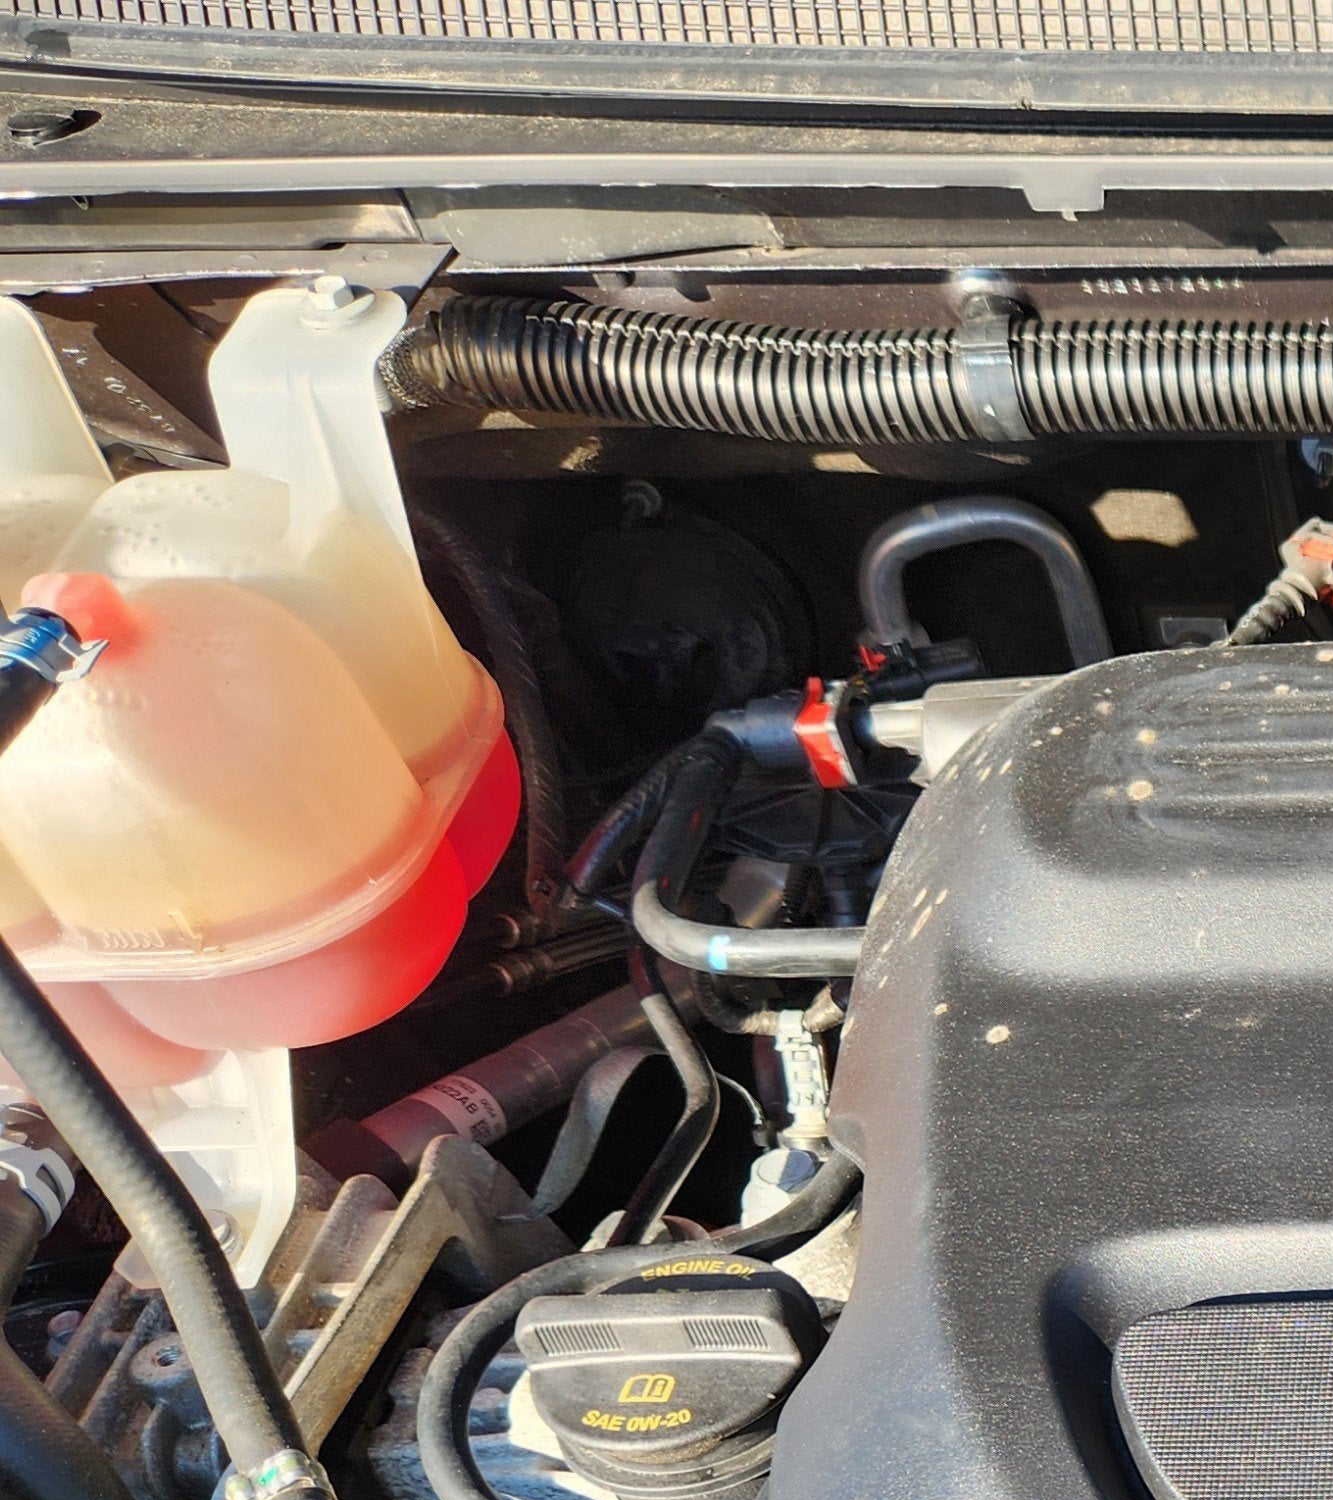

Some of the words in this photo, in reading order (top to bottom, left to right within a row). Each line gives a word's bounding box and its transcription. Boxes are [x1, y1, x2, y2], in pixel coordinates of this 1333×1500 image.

[640, 1260, 725, 1281] ENGINE
[725, 1263, 756, 1281] OIL
[581, 1409, 626, 1432] SAE
[625, 1408, 692, 1432] 0W-20
